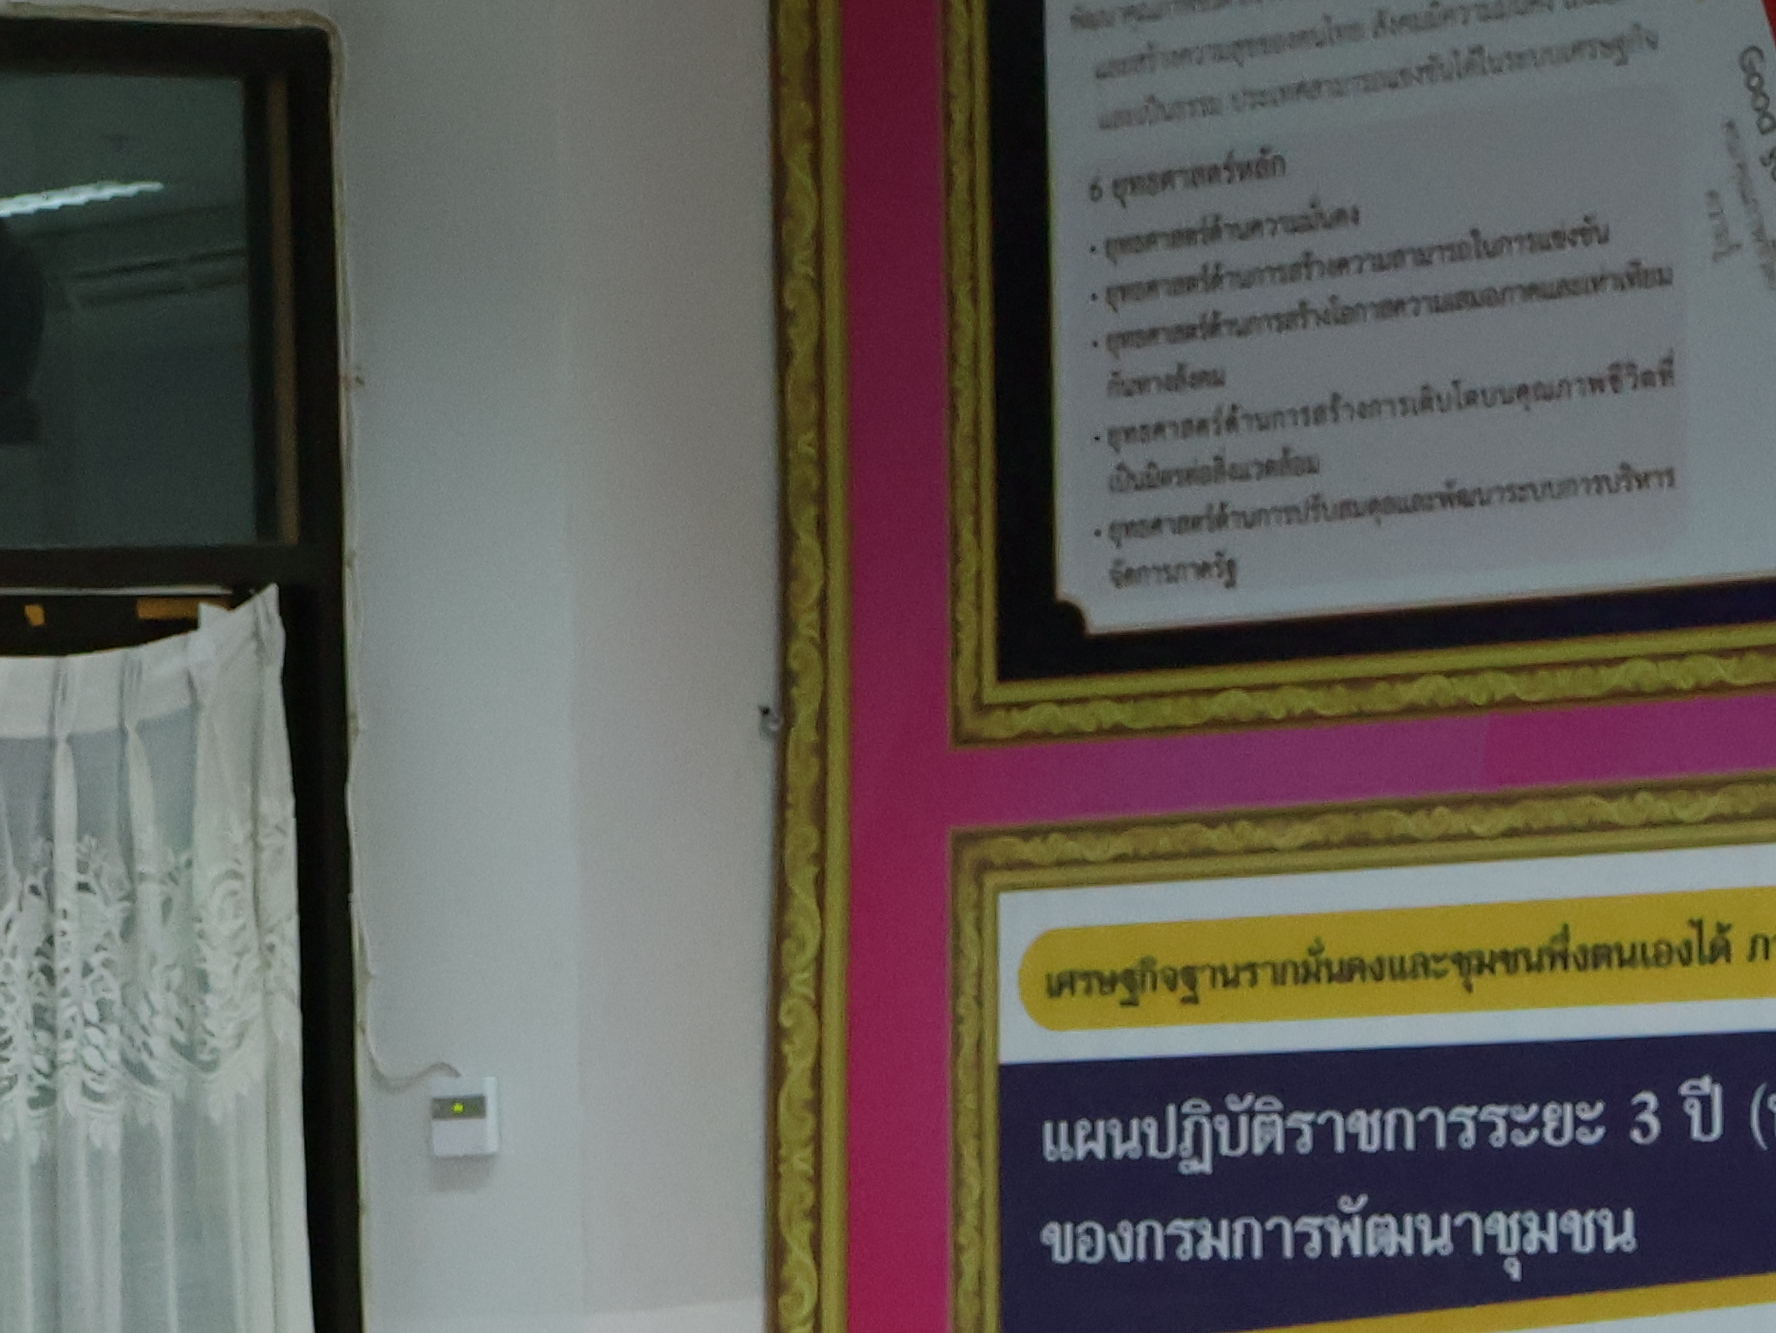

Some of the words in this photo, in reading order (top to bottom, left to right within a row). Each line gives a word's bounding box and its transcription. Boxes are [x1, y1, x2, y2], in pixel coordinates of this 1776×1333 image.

[1042, 1090, 1606, 1175] แผนปฏิบัติราชการระยะ
[1629, 1089, 1662, 1146] 3
[1677, 1073, 1725, 1143] ปี
[1041, 1194, 1637, 1281] ของกรมการพัฒนาชุมชน
